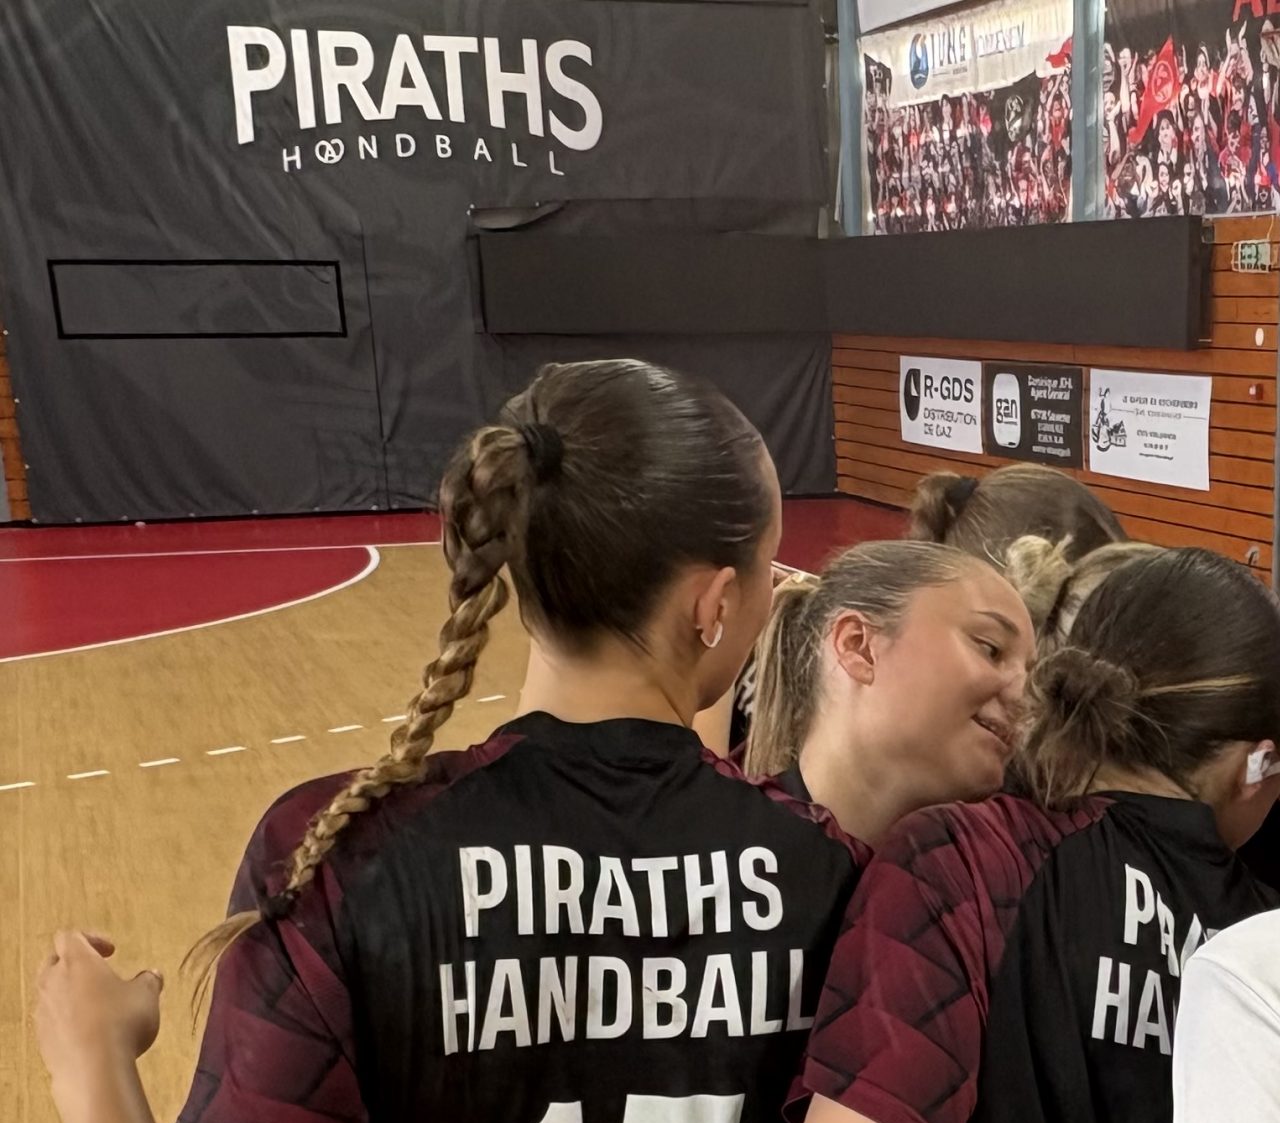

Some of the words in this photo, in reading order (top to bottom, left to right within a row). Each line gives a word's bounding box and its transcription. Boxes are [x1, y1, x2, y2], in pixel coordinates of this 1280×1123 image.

[227, 25, 603, 151] PIRATHS
[282, 133, 565, 176] HANDBALL
[924, 374, 974, 403] R-GDS
[459, 844, 784, 937] PIRATHS
[439, 948, 816, 1056] HANDBALL
